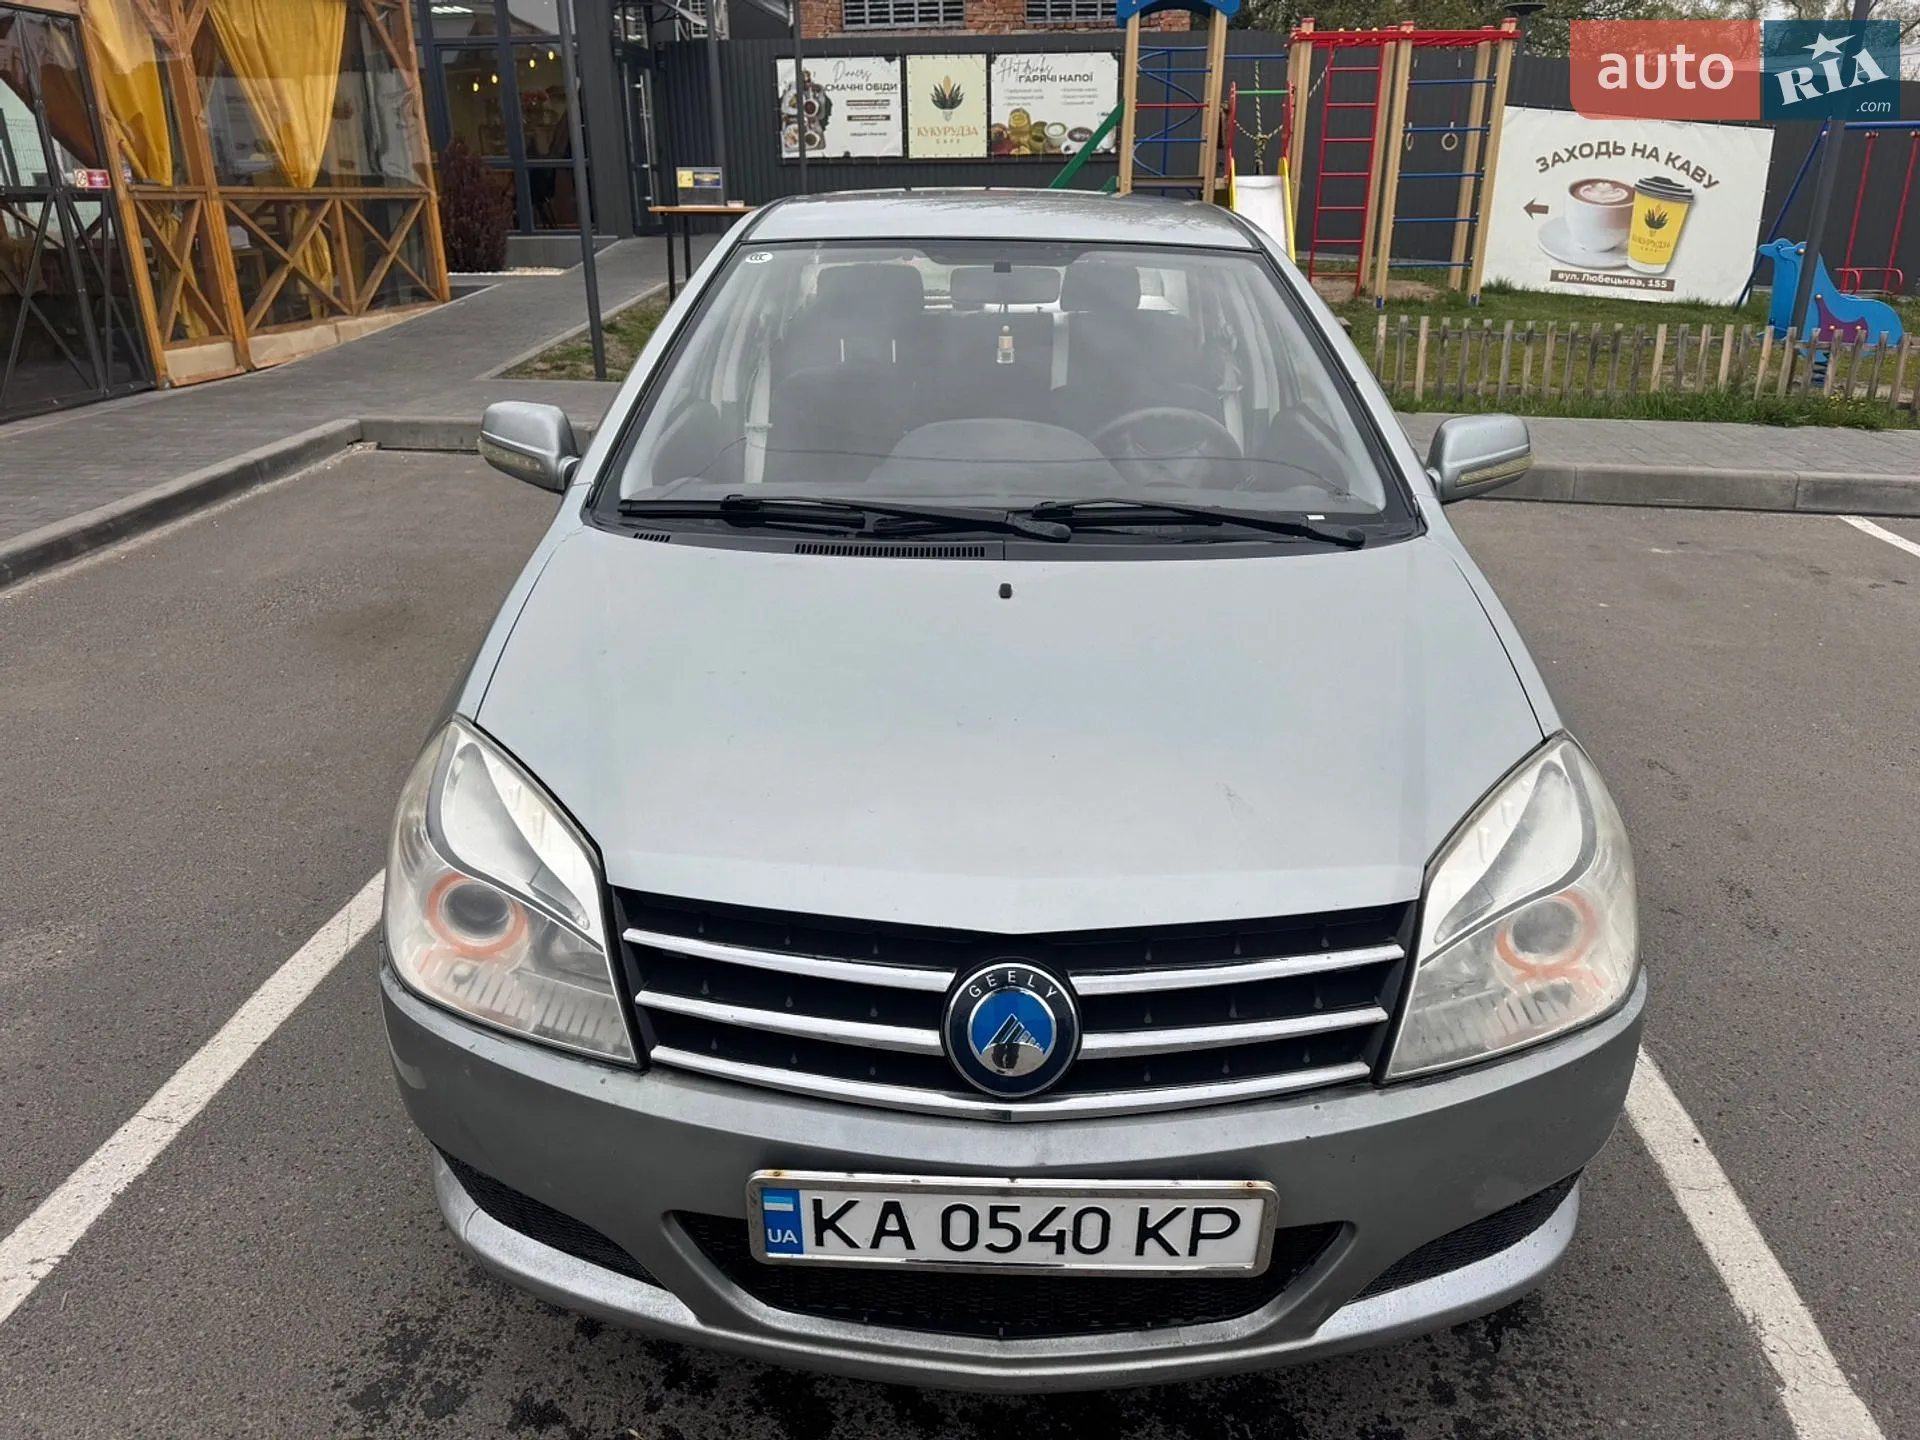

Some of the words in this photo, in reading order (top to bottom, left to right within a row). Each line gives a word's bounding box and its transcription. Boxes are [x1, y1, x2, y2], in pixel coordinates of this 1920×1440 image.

[1059, 72, 1093, 83] НАПОЇ
[825, 83, 863, 92] СМАЧНІ
[865, 82, 898, 92] ОБІДИ
[916, 126, 979, 137] КУКУРУДЗА
[1535, 140, 1626, 174] ЗАХОДЬ
[1631, 142, 1660, 163] НА
[1664, 151, 1720, 189] КАВУ
[1558, 272, 1580, 282] вул.
[1648, 279, 1668, 288] 155
[969, 970, 1057, 998] GEELY
[811, 1198, 916, 1251] KA
[940, 1202, 1110, 1256] 0540
[1134, 1205, 1242, 1257] KP
[767, 1229, 799, 1245] UA
